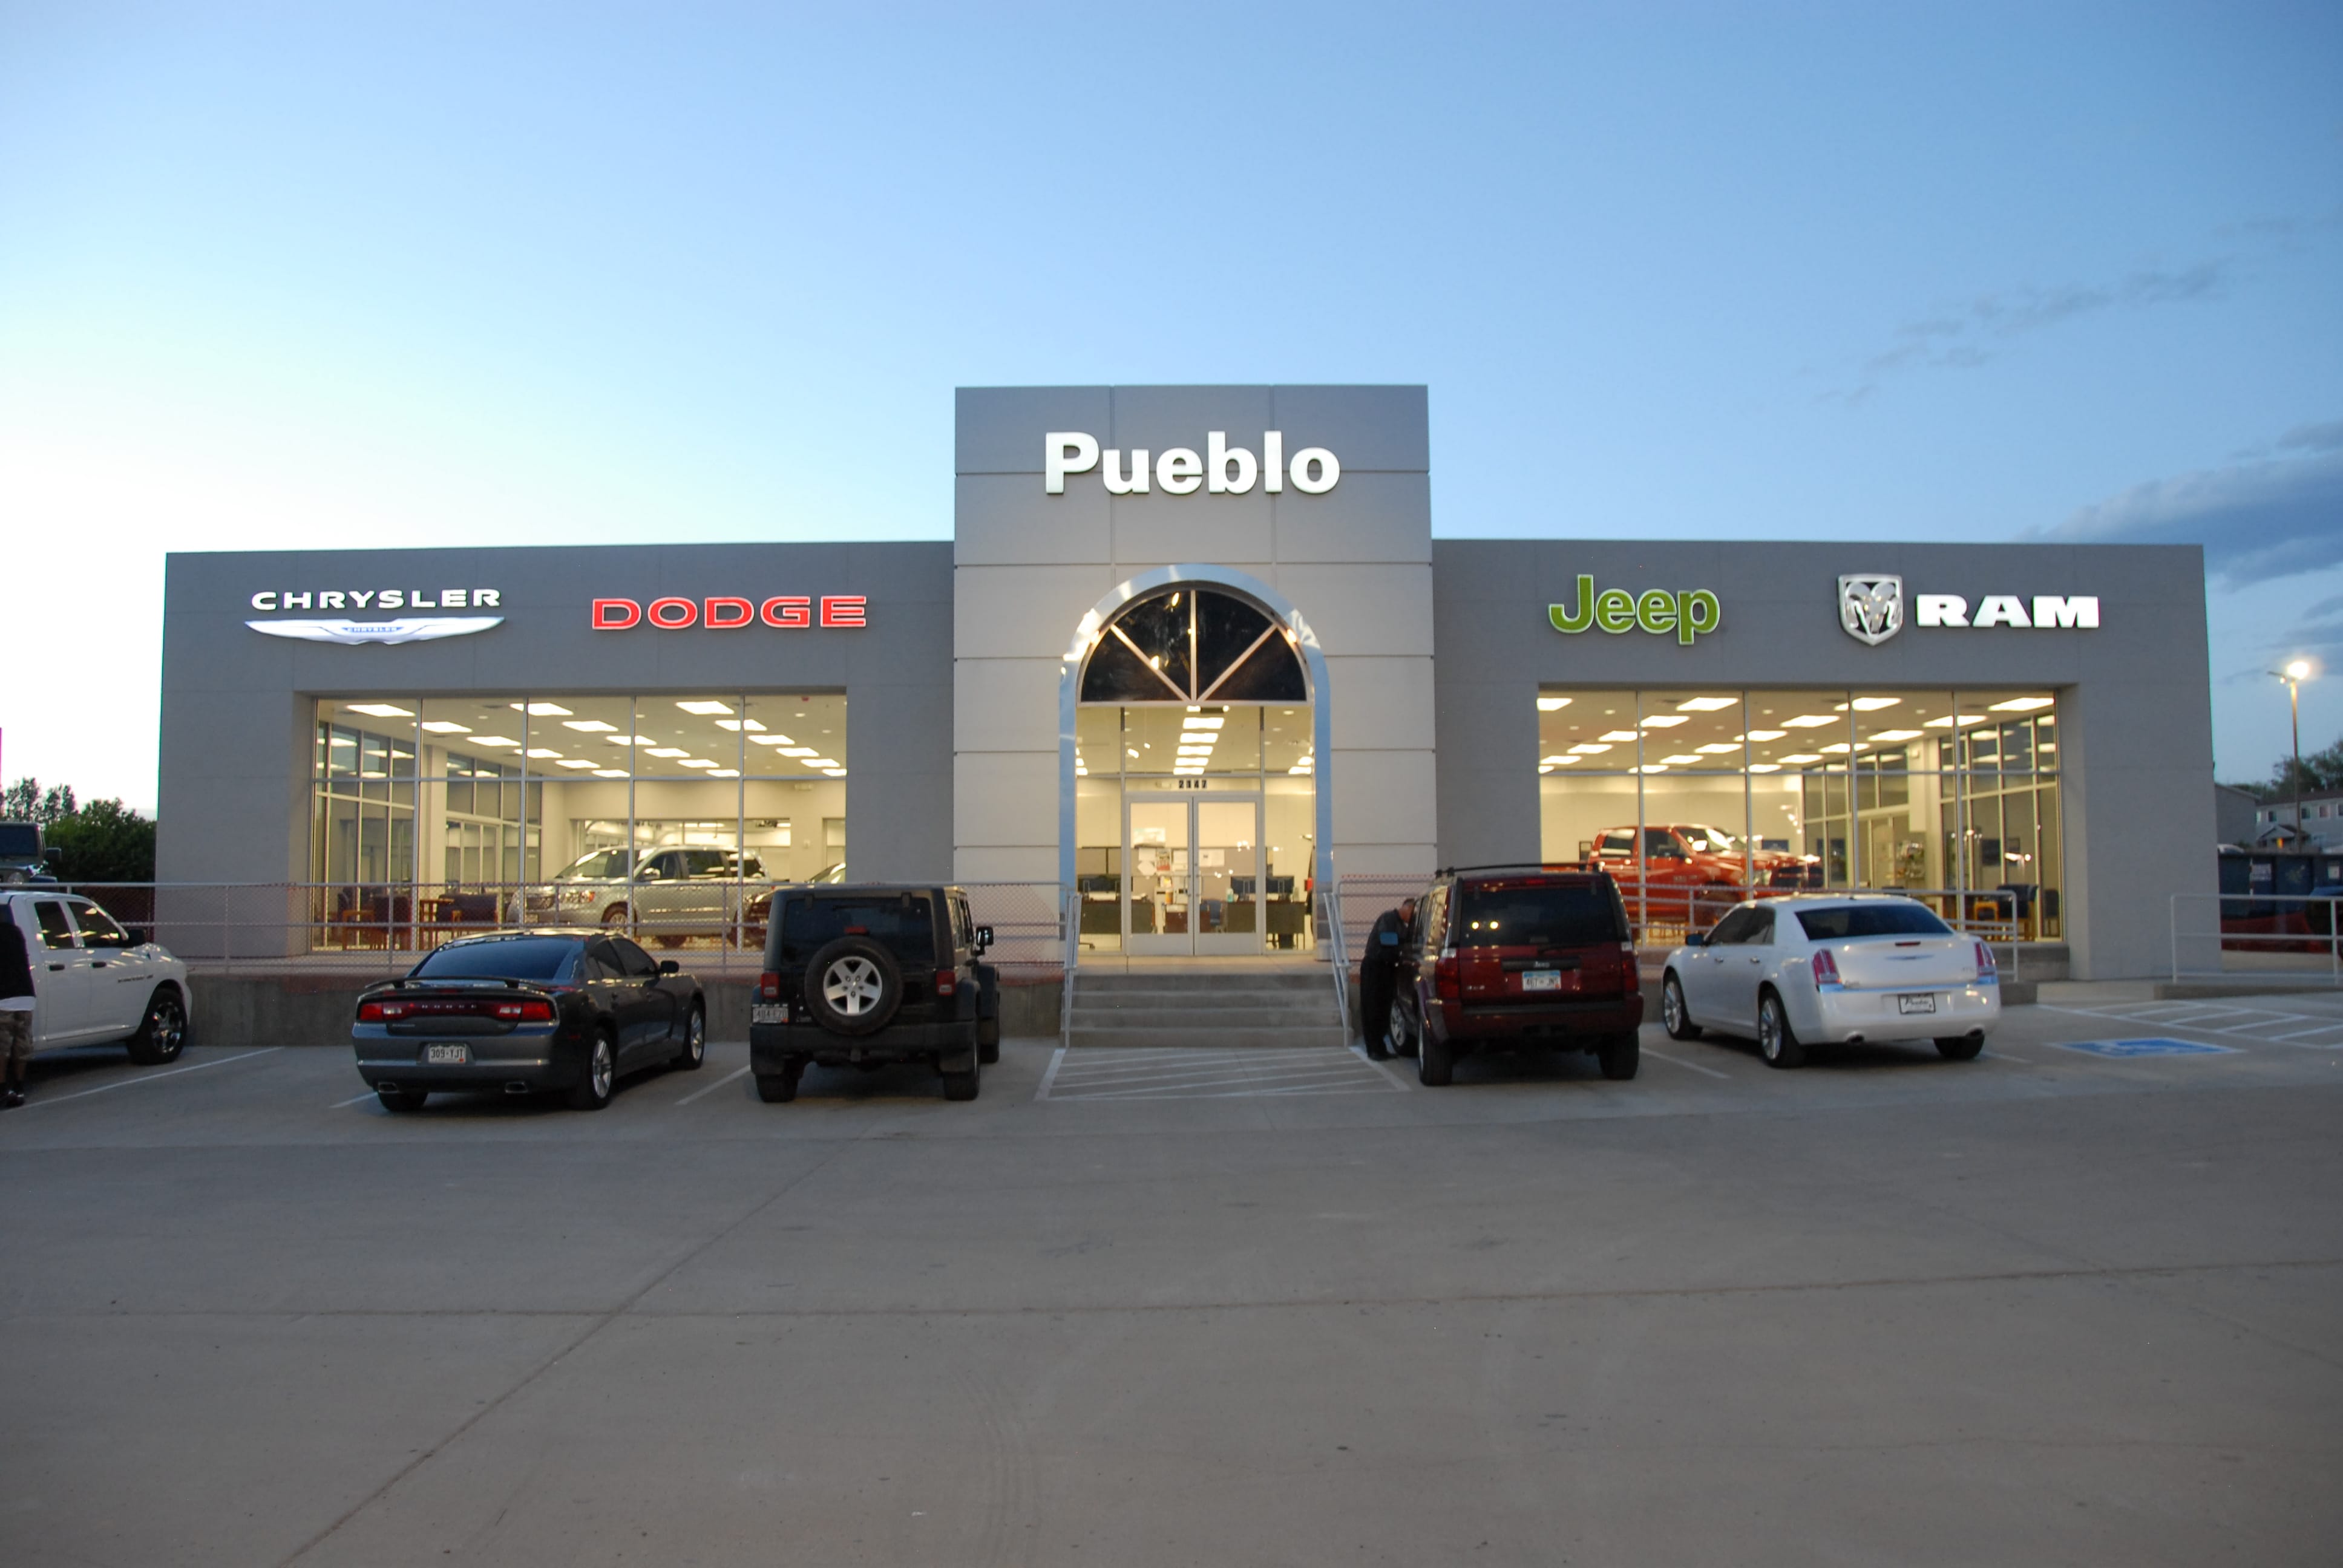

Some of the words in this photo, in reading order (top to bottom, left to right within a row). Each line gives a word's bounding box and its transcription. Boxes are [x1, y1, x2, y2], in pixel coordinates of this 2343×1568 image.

[1046, 431, 1340, 495] Pueblo
[252, 589, 500, 610] CHRYSLER
[592, 596, 867, 630] DODGE
[1548, 574, 1720, 645] Jeep
[1916, 594, 2099, 628] RAM
